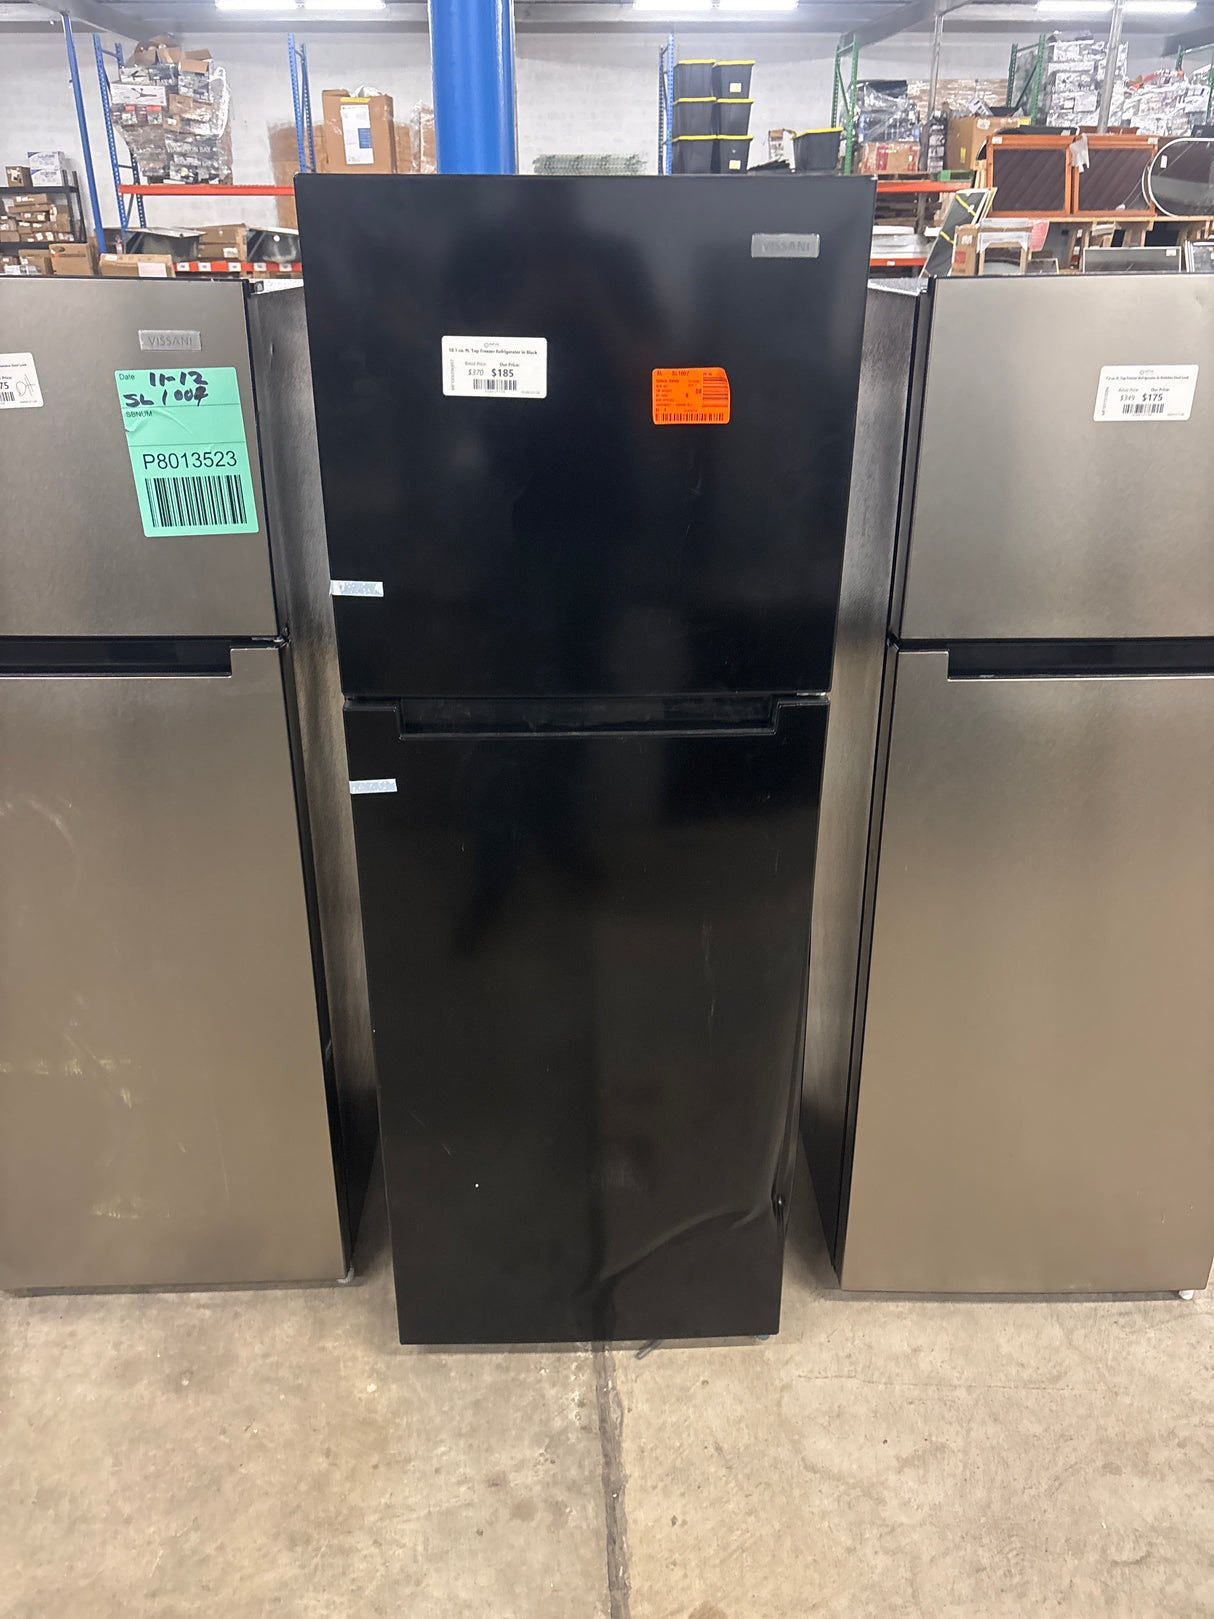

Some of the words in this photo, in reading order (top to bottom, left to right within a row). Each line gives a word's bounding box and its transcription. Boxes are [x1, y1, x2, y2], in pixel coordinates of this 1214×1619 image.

[762, 240, 810, 252] VISSANI
[149, 334, 193, 347] VISSANI
[119, 373, 135, 381] Date
[468, 368, 484, 376] $370
[491, 368, 514, 377] $185
[123, 393, 154, 407] SL
[1142, 393, 1163, 402] $175
[142, 450, 237, 470] P8013523
